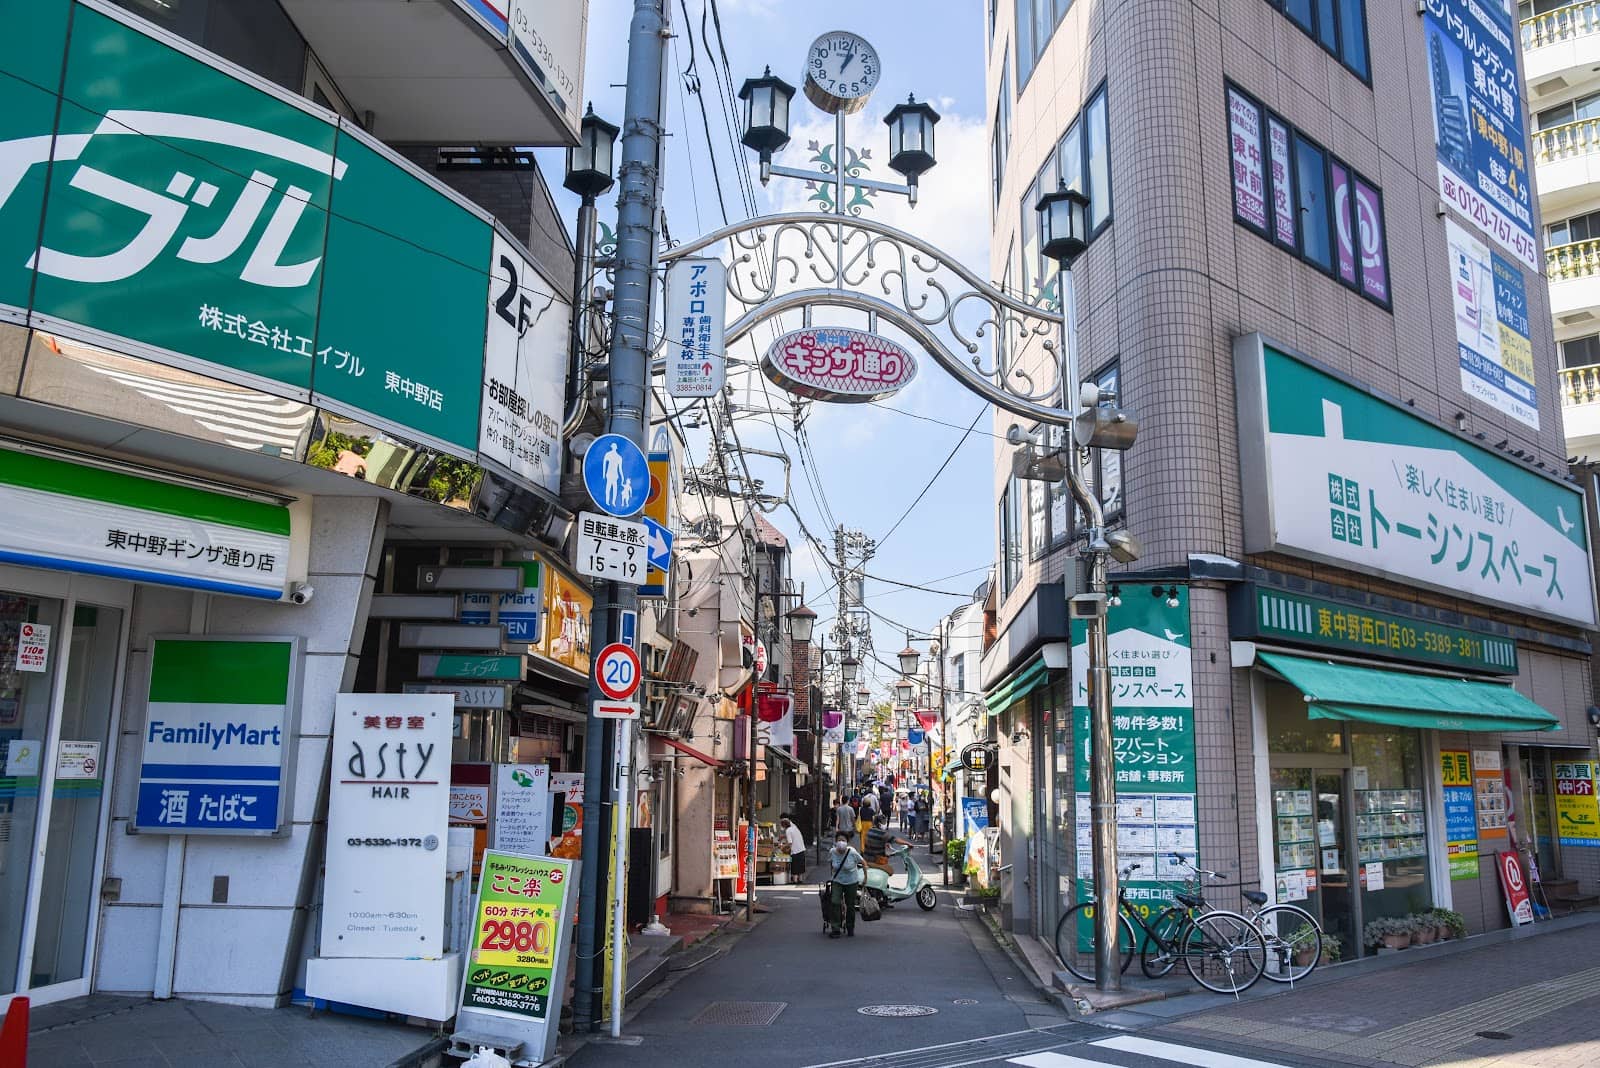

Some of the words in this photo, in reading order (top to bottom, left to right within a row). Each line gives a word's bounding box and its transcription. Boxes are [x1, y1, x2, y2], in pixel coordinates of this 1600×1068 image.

[516, 7, 574, 98] 03-5330-1372
[817, 49, 829, 58] 10
[839, 40, 850, 51] 12
[861, 53, 868, 63] 2
[815, 58, 823, 68] 9
[818, 69, 827, 79] 8
[864, 65, 872, 75] 3
[828, 79, 835, 88] 7
[839, 83, 847, 93] 6
[851, 82, 859, 92] 5
[860, 76, 868, 85] 4
[1472, 59, 1514, 122] 東中野
[1457, 188, 1535, 264] 0120-767-675
[496, 254, 532, 333] 2F
[690, 265, 706, 314] アポロ
[199, 303, 365, 377] 株式会社エイブル
[681, 316, 694, 360] 専門学校
[698, 315, 711, 360] 歯科衛生士
[785, 336, 903, 382] ギンザ通り
[384, 371, 444, 411] 東中野店
[489, 377, 559, 441] お部屋探しの窓口
[1405, 463, 1505, 525] 楽しく住まい選び
[584, 519, 645, 544] 自転車を除く
[105, 529, 275, 573] 東中野ギンザ通り店
[1368, 488, 1564, 601] トーシンスペース
[425, 572, 433, 582] 6
[1318, 608, 1400, 648] 東中野西口店
[1401, 627, 1481, 659] 03-5389-3811
[606, 659, 632, 684] 20
[363, 716, 425, 729] 美容室
[149, 721, 280, 750] FamilyMart
[1114, 738, 1169, 751] アパート
[348, 741, 434, 779] asty
[1115, 751, 1184, 764] マンション
[1442, 754, 1471, 782] 売買
[1556, 764, 1588, 778] 売買
[372, 786, 409, 799] HAIR
[1558, 780, 1591, 794] 仲介
[158, 789, 190, 824] 酒
[198, 793, 257, 822] たばこ
[347, 838, 422, 847] 03-5330-1372
[492, 875, 542, 898] ここ楽
[550, 872, 562, 881] 2F
[485, 906, 508, 917] 60分
[511, 907, 536, 917] ボディ
[347, 924, 375, 932] Closed
[481, 919, 549, 953] 2980
[491, 973, 509, 985] アロマ
